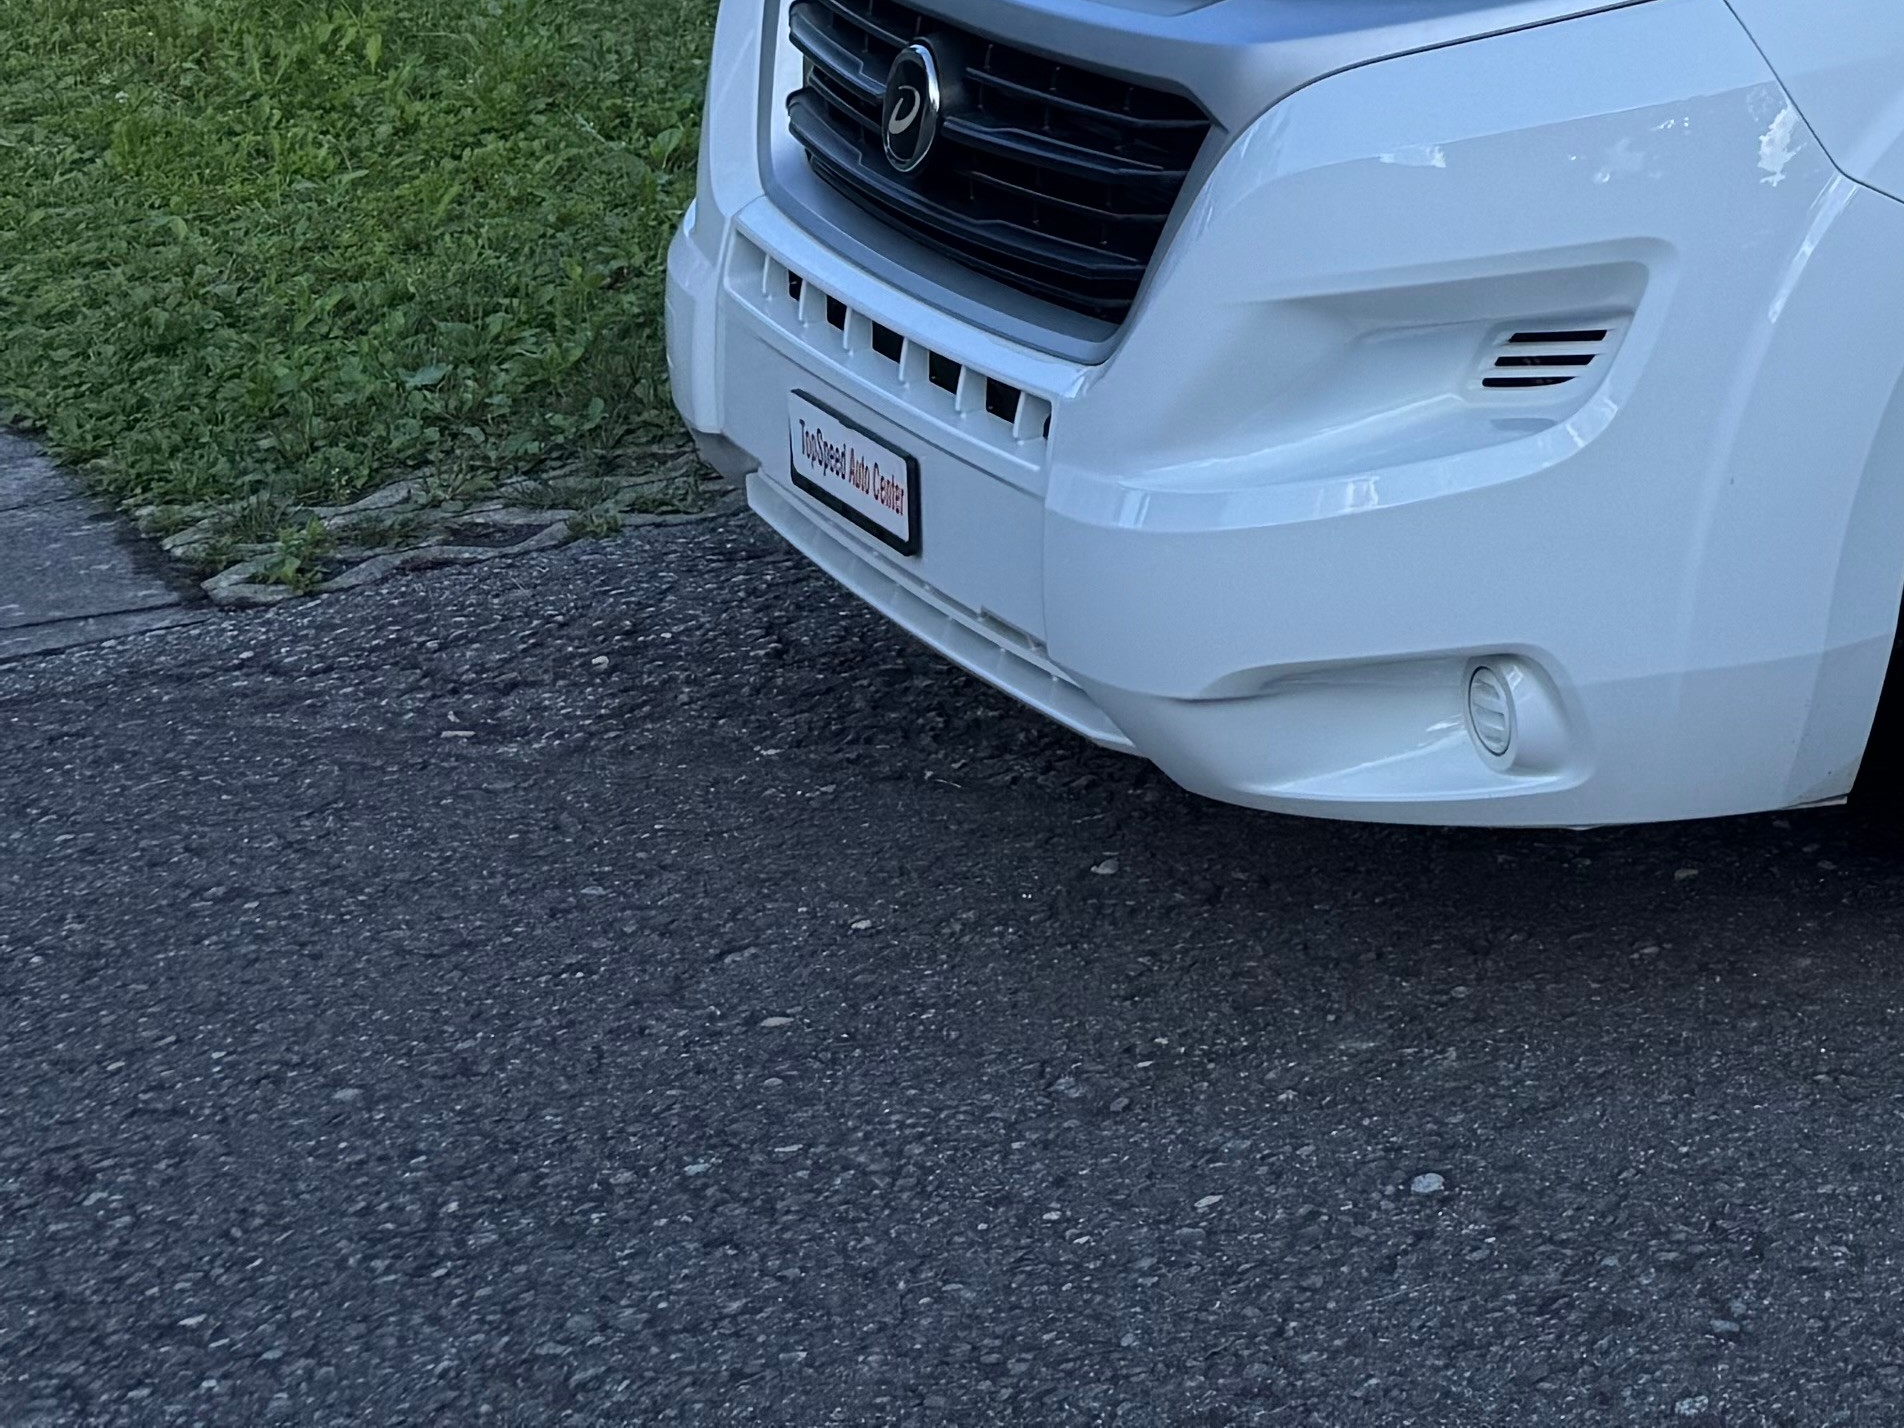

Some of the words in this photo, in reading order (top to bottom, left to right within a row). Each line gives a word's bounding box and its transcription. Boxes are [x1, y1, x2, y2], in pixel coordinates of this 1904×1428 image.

[799, 418, 847, 480] TopSpeed
[849, 446, 871, 495] Auto
[873, 461, 904, 516] Center
